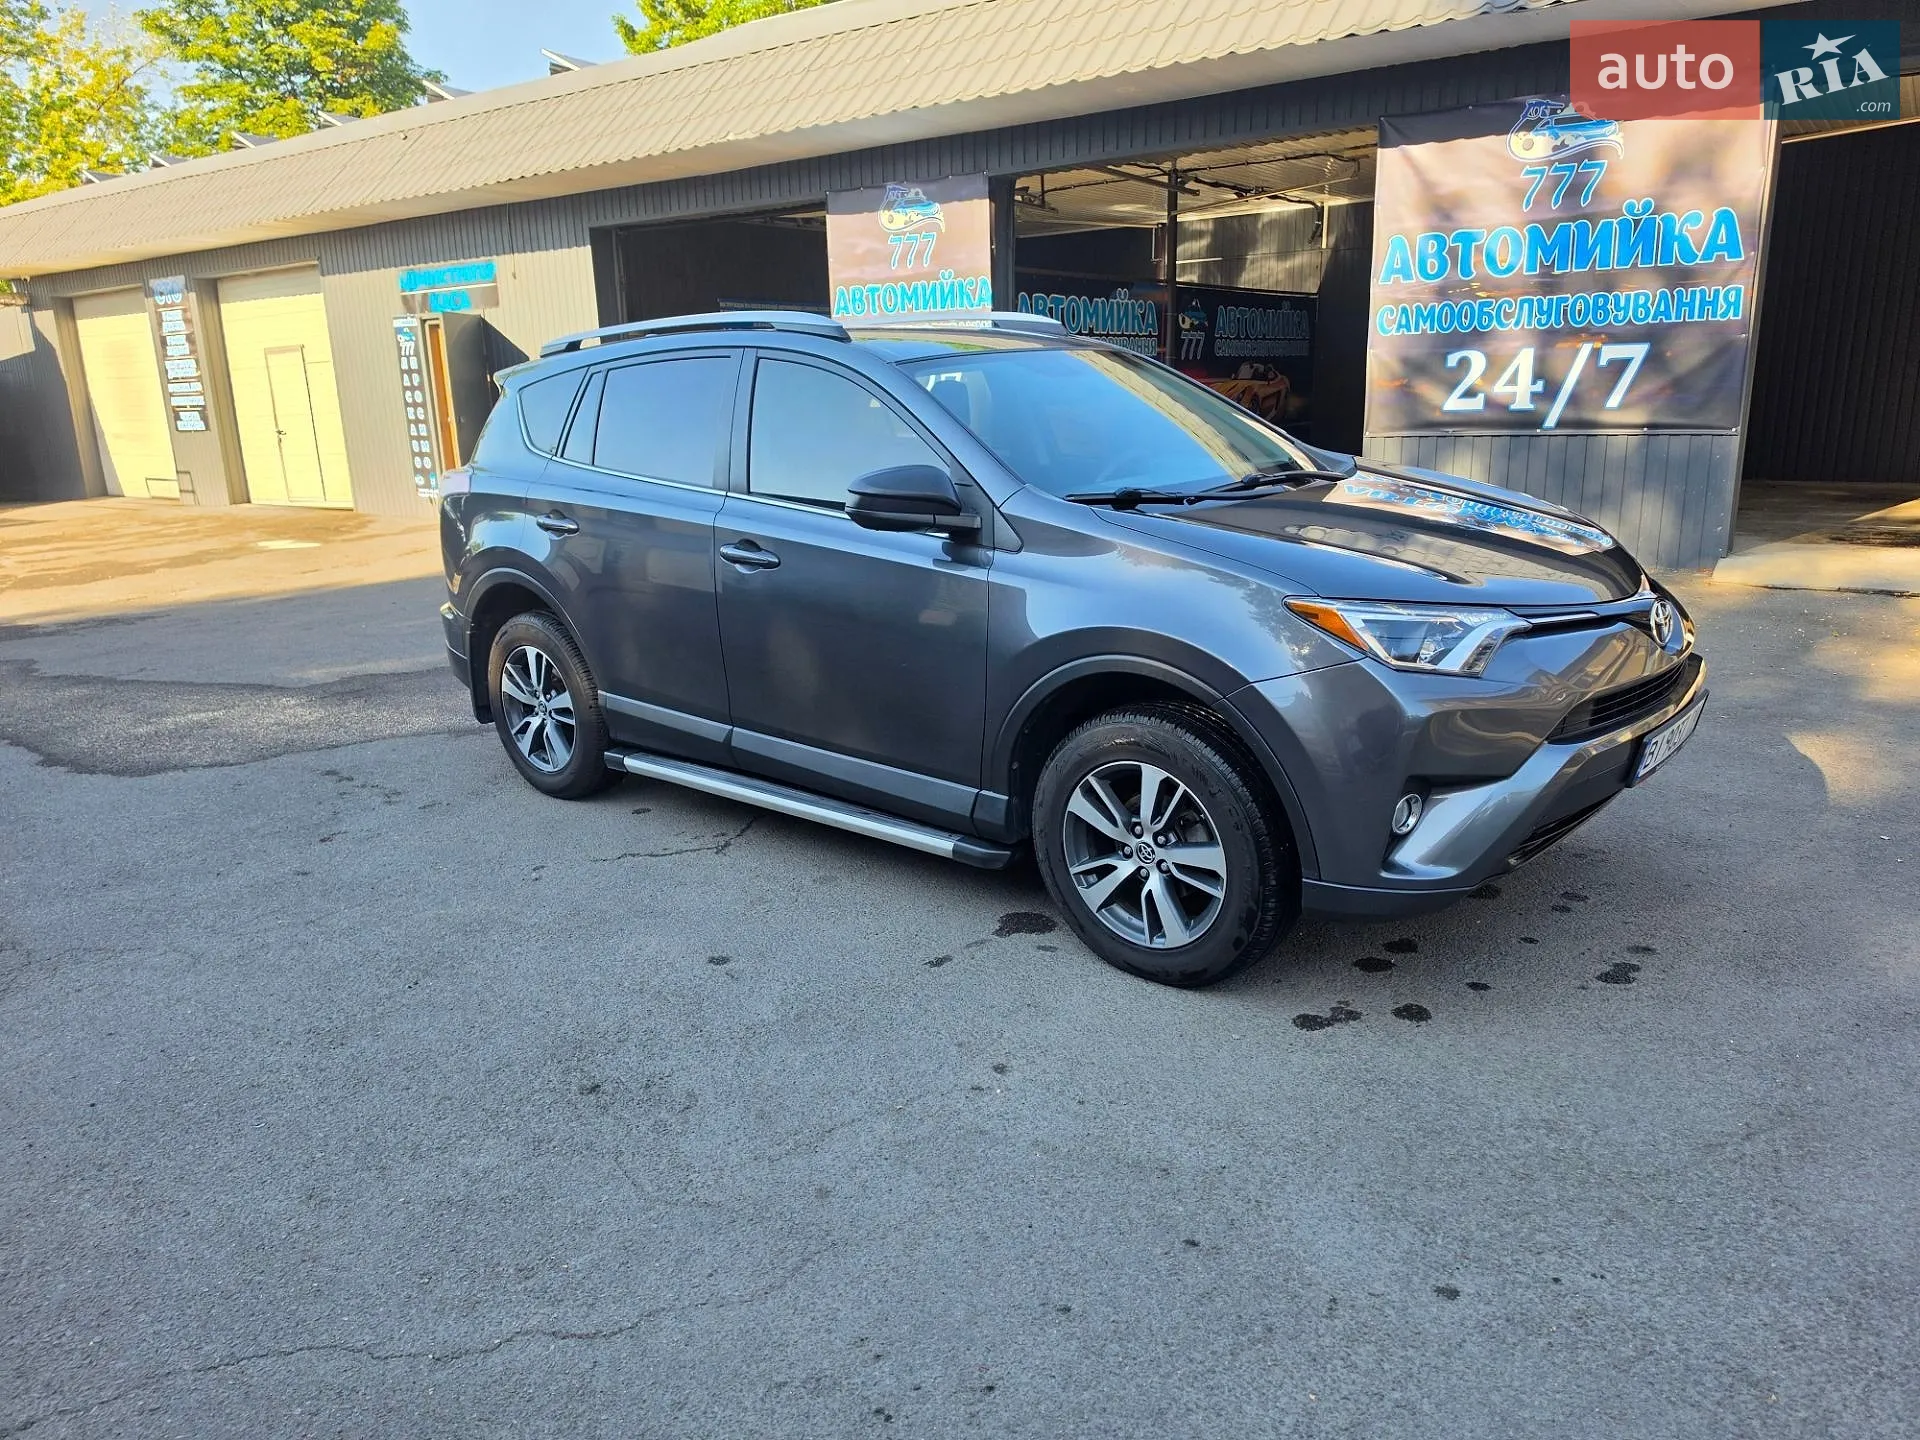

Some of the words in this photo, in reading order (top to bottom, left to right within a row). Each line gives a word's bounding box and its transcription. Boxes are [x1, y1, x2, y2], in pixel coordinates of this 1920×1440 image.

[1520, 158, 1608, 213] 777
[888, 231, 937, 270] 777
[1379, 198, 1744, 284] АВТОМИЙКА
[834, 269, 992, 318] АВТОМИЙКА
[1376, 285, 1744, 336] САМООБСЛУГОВУВАННЯ
[1180, 330, 1206, 361] 777
[1442, 341, 1651, 430] 24/7
